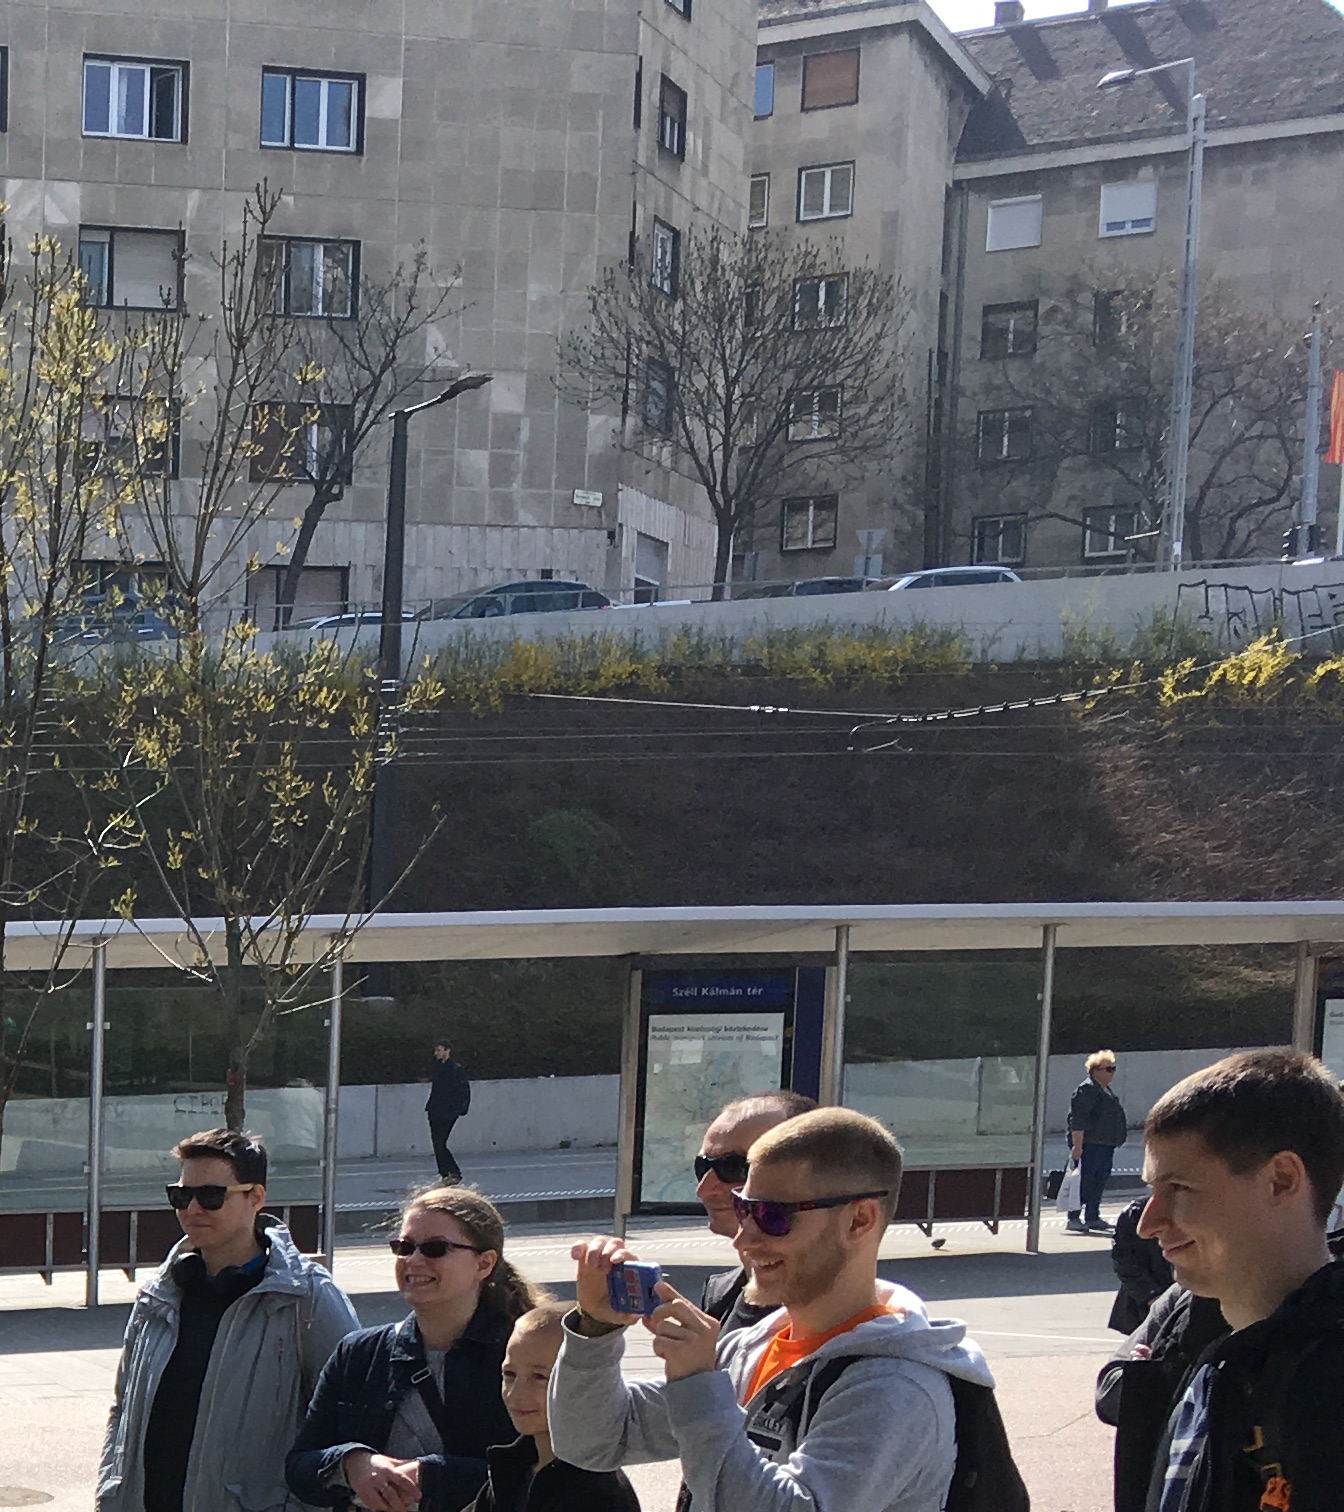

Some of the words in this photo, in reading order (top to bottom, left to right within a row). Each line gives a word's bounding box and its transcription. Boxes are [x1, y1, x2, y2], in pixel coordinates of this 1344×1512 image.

[672, 986, 698, 997] Széll
[701, 986, 743, 996] Kálmán
[747, 986, 763, 996] tér
